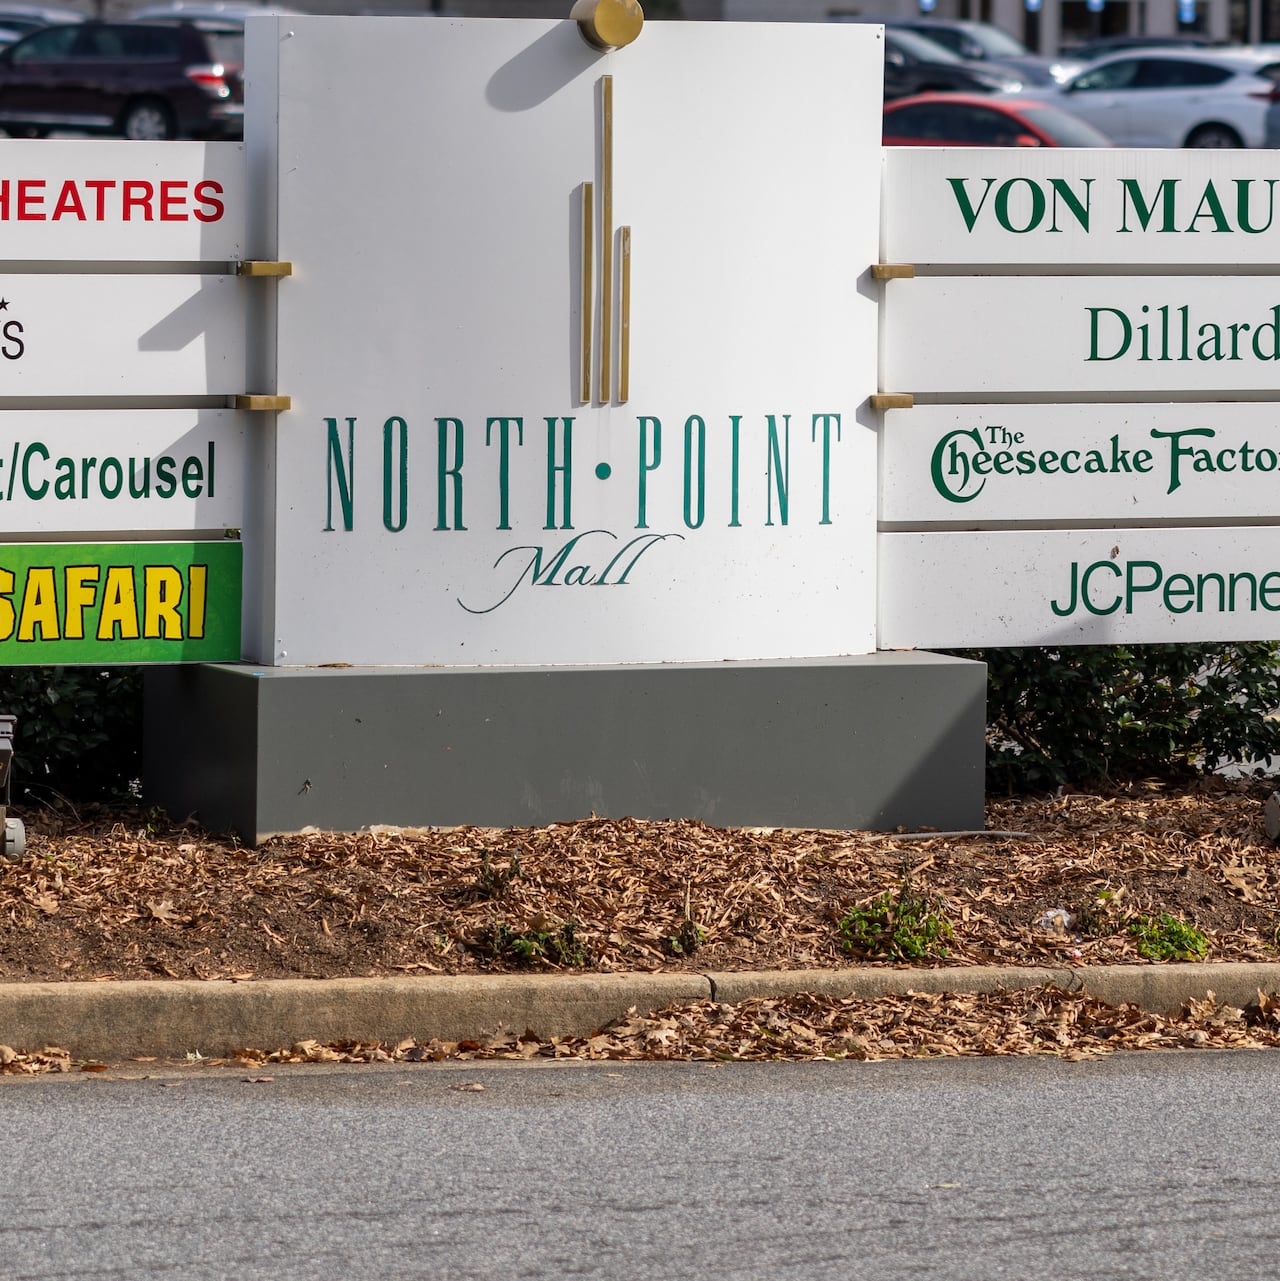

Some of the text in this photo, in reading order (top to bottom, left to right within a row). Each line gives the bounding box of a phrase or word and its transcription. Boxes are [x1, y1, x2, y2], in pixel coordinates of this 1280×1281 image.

[946, 177, 1096, 235] VON
[322, 412, 843, 532] NORTH POINT
[930, 428, 1154, 504] Cheesecake
[986, 426, 1025, 446] The
[456, 529, 686, 614] Mall
